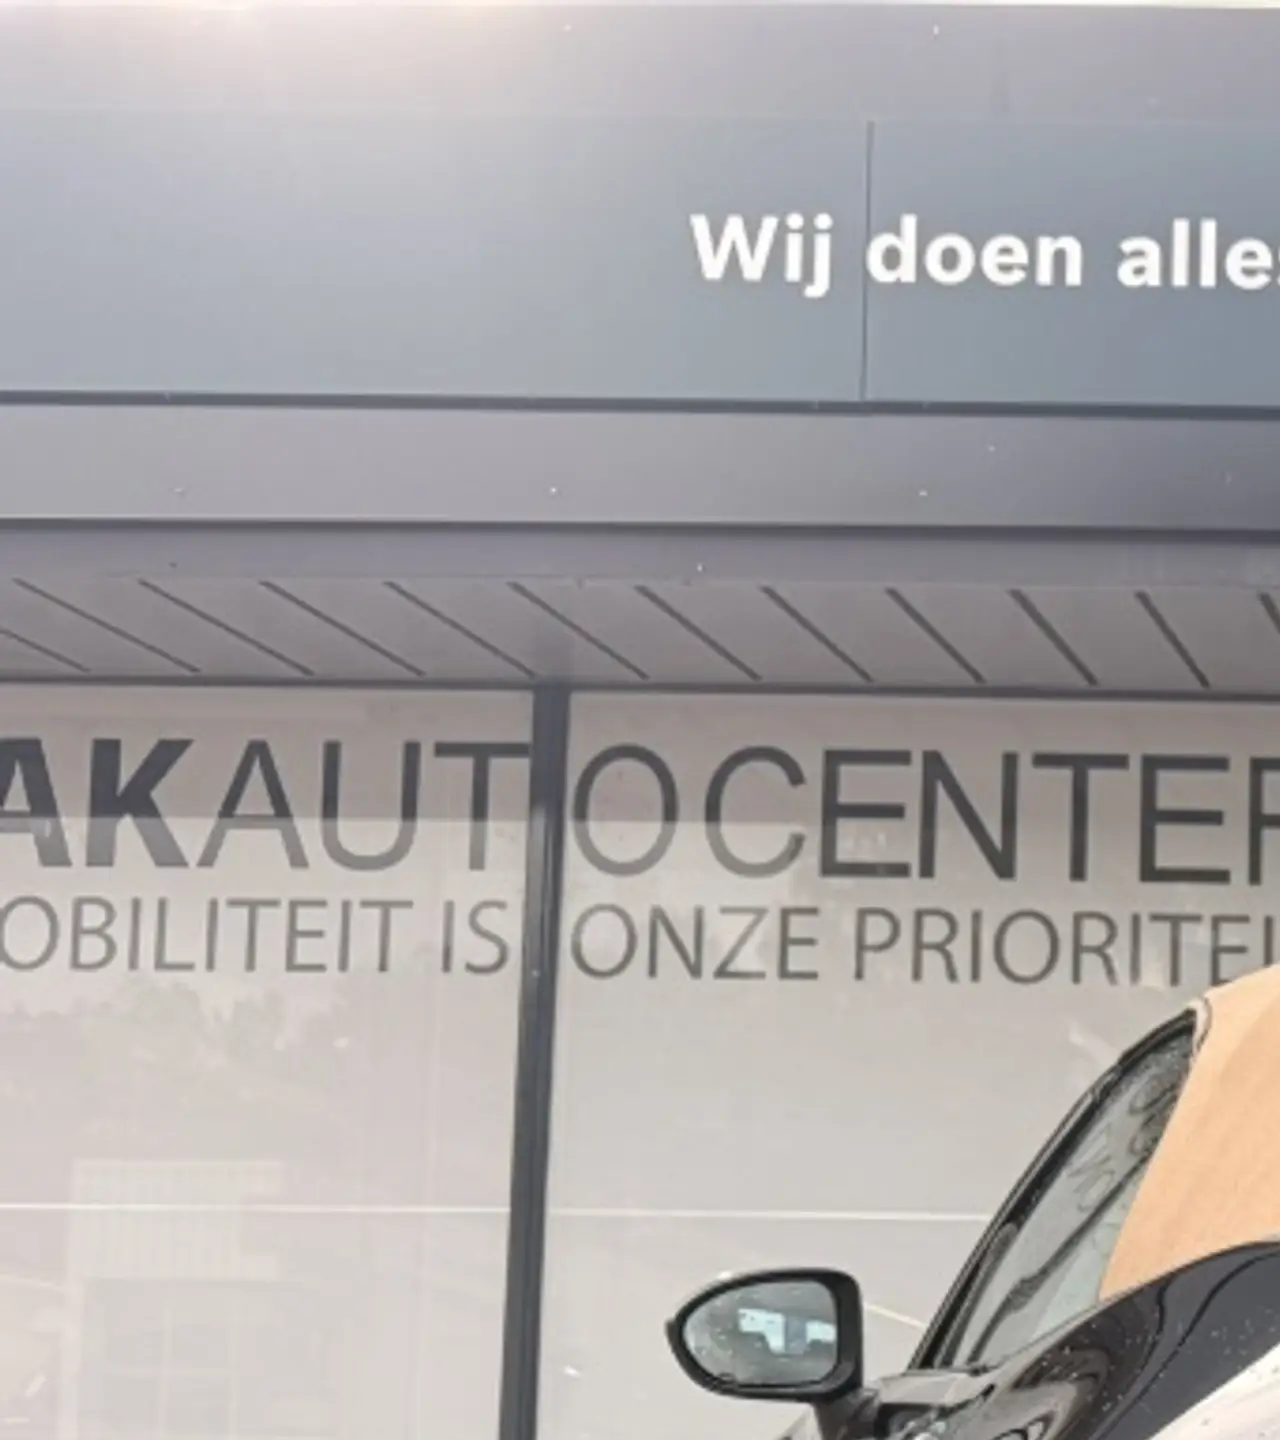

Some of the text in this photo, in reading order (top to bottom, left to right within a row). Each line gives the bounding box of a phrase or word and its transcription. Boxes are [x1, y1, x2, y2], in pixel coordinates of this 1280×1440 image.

[690, 212, 834, 299] Wij
[866, 214, 1084, 287] doen
[441, 900, 509, 975] IS
[571, 903, 820, 982] ONZE
